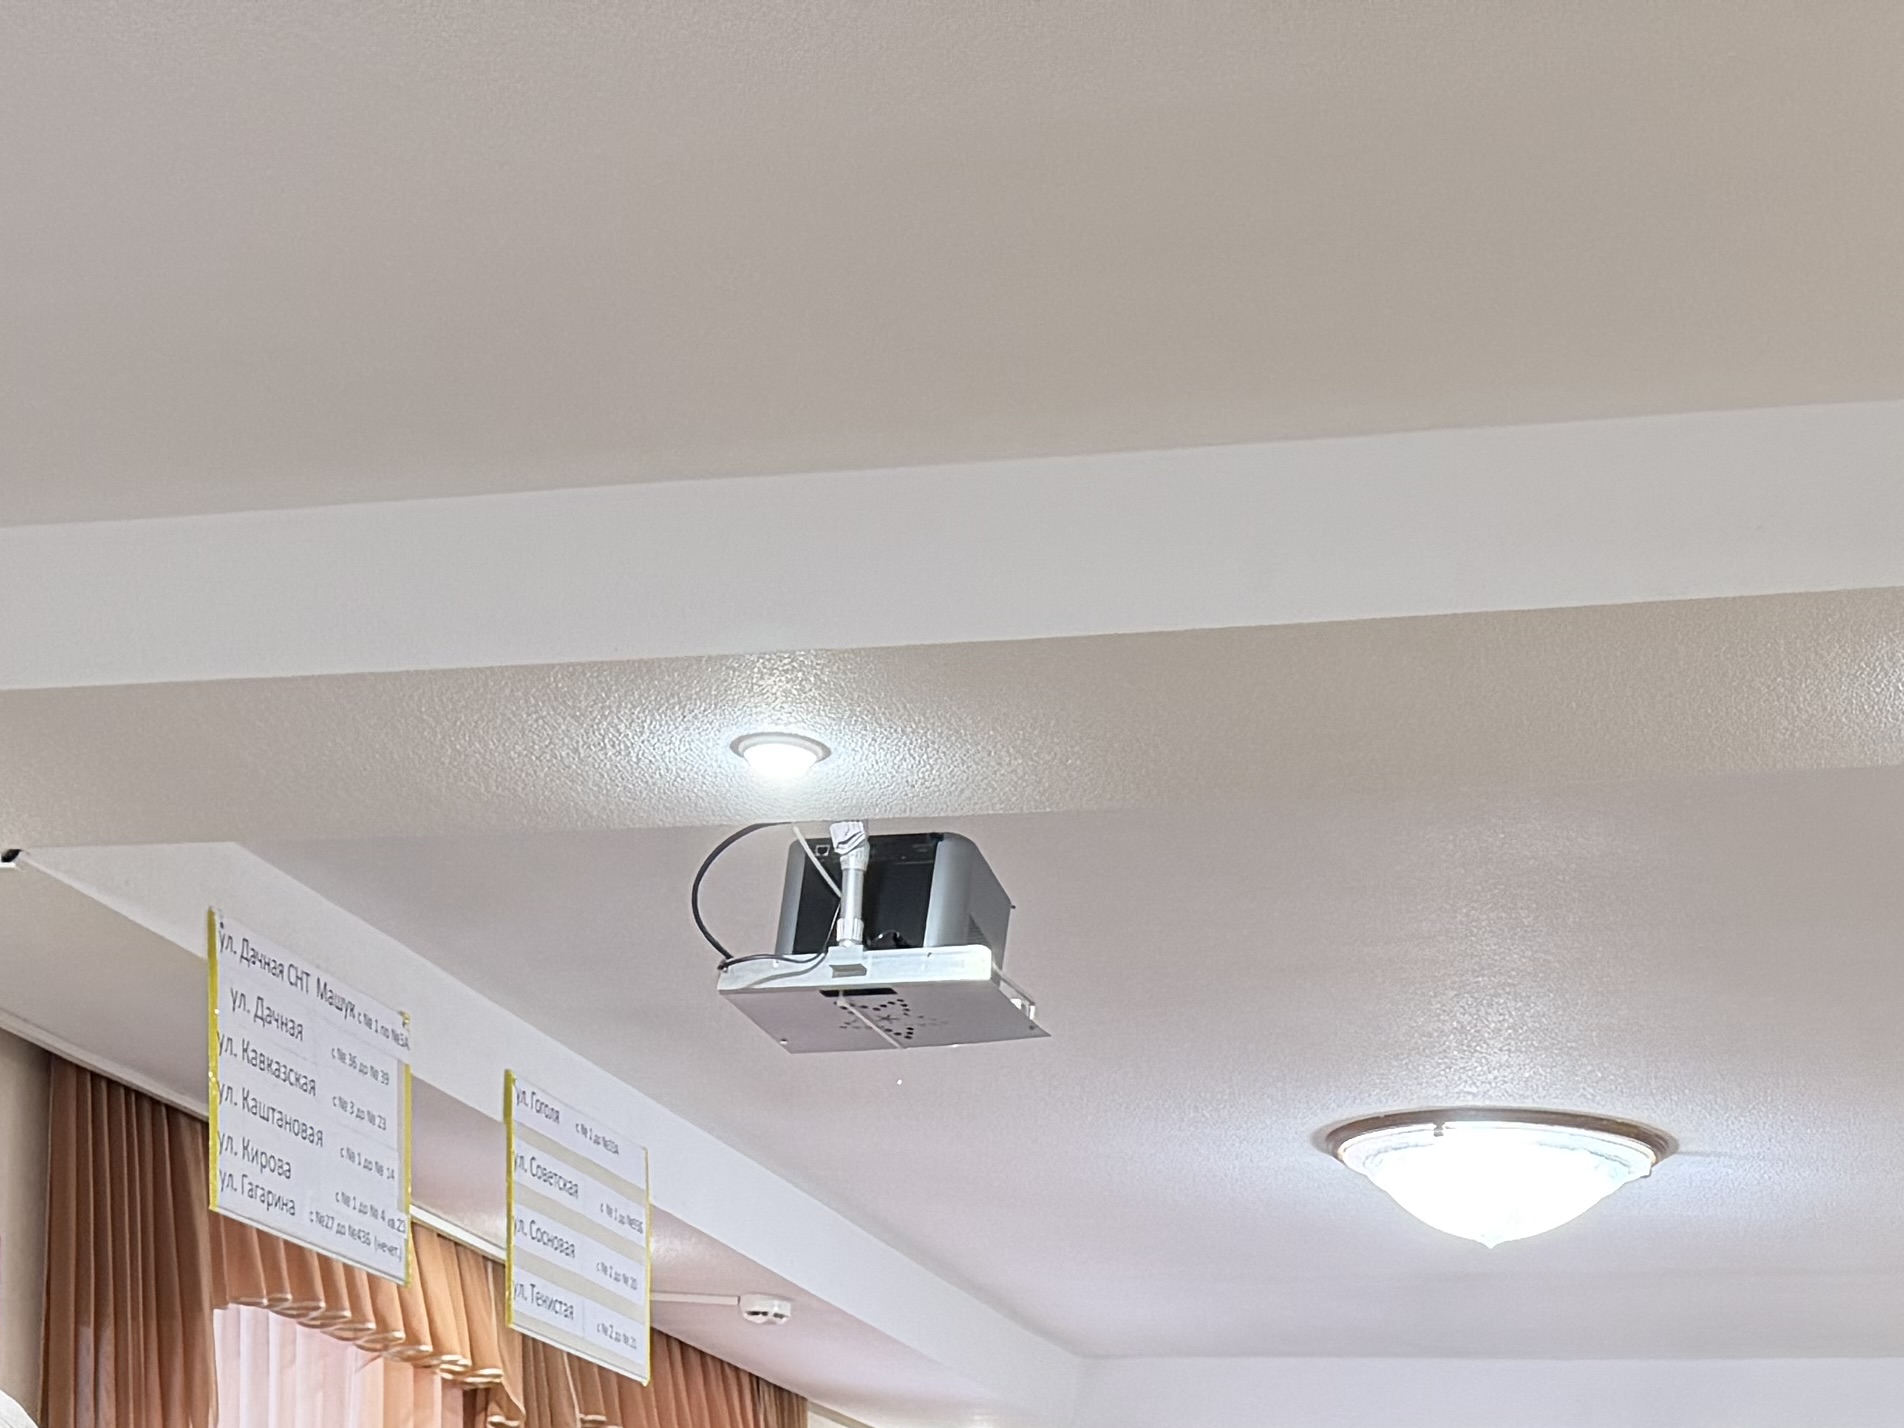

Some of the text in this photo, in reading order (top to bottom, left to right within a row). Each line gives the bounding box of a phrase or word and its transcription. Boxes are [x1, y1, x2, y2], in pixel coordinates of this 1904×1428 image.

[239, 937, 284, 981] Дачная
[230, 986, 251, 1014] ул.
[254, 995, 303, 1042] Дачная
[242, 1038, 316, 1097] Кавказская
[242, 1087, 323, 1148] Каштановая
[242, 1136, 291, 1180] Кирова
[530, 1156, 578, 1199] Советская
[241, 1173, 296, 1216] Гагарина
[529, 1219, 575, 1259] Сосновая
[529, 1283, 574, 1320] Тенистая
